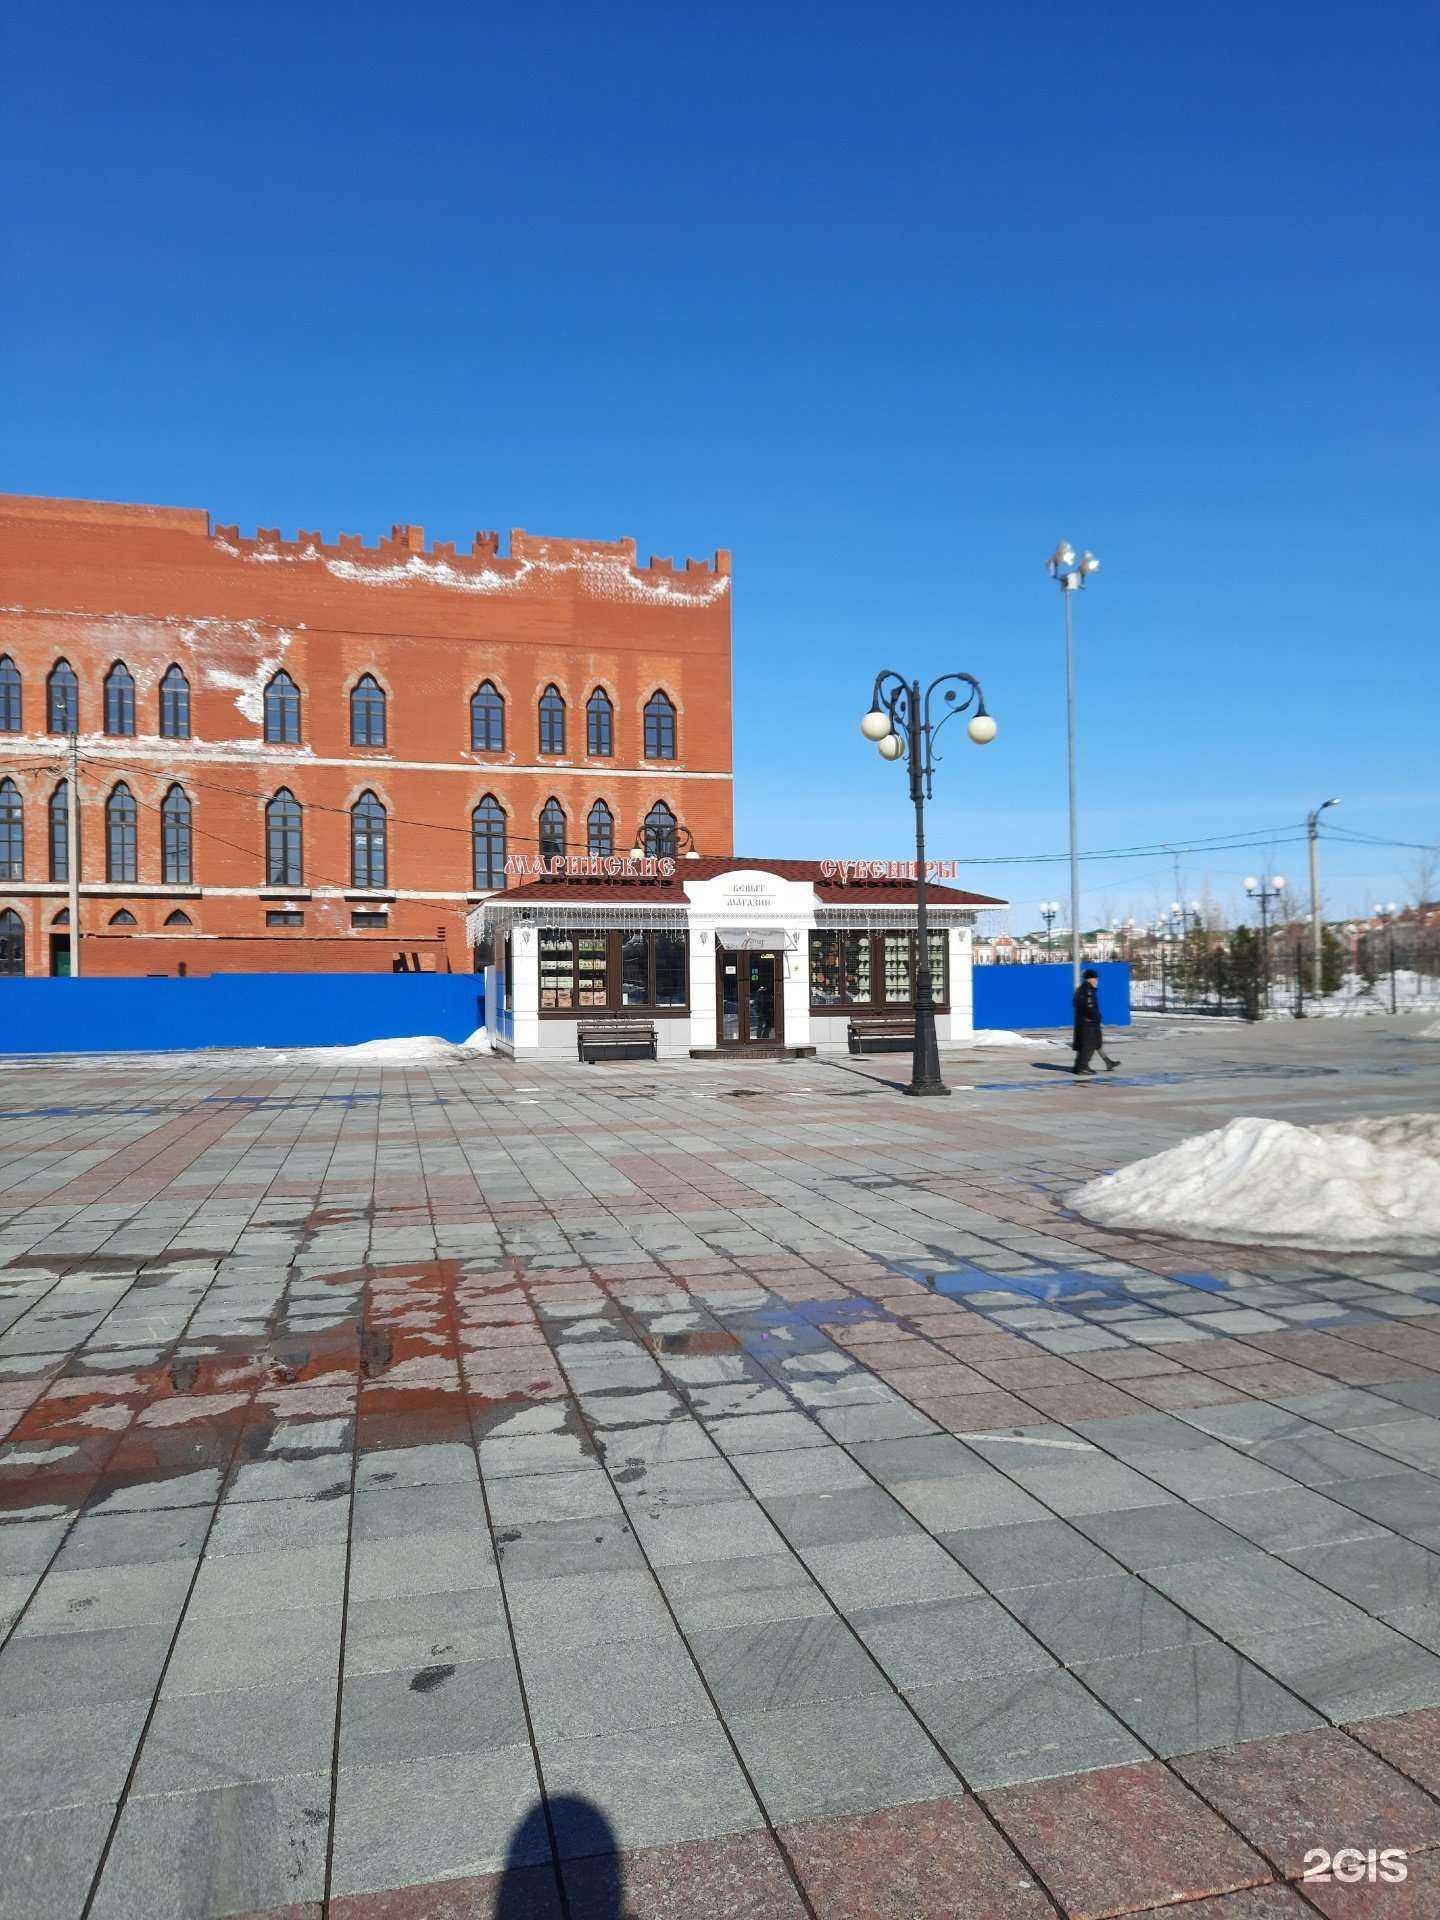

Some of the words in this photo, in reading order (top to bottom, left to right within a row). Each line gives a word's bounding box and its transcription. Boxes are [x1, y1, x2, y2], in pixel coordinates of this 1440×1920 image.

[504, 850, 676, 877] МАРИЙСКИЕ
[820, 859, 959, 883] СУВЕНИРЫ
[727, 898, 771, 907] МАГАЗИН
